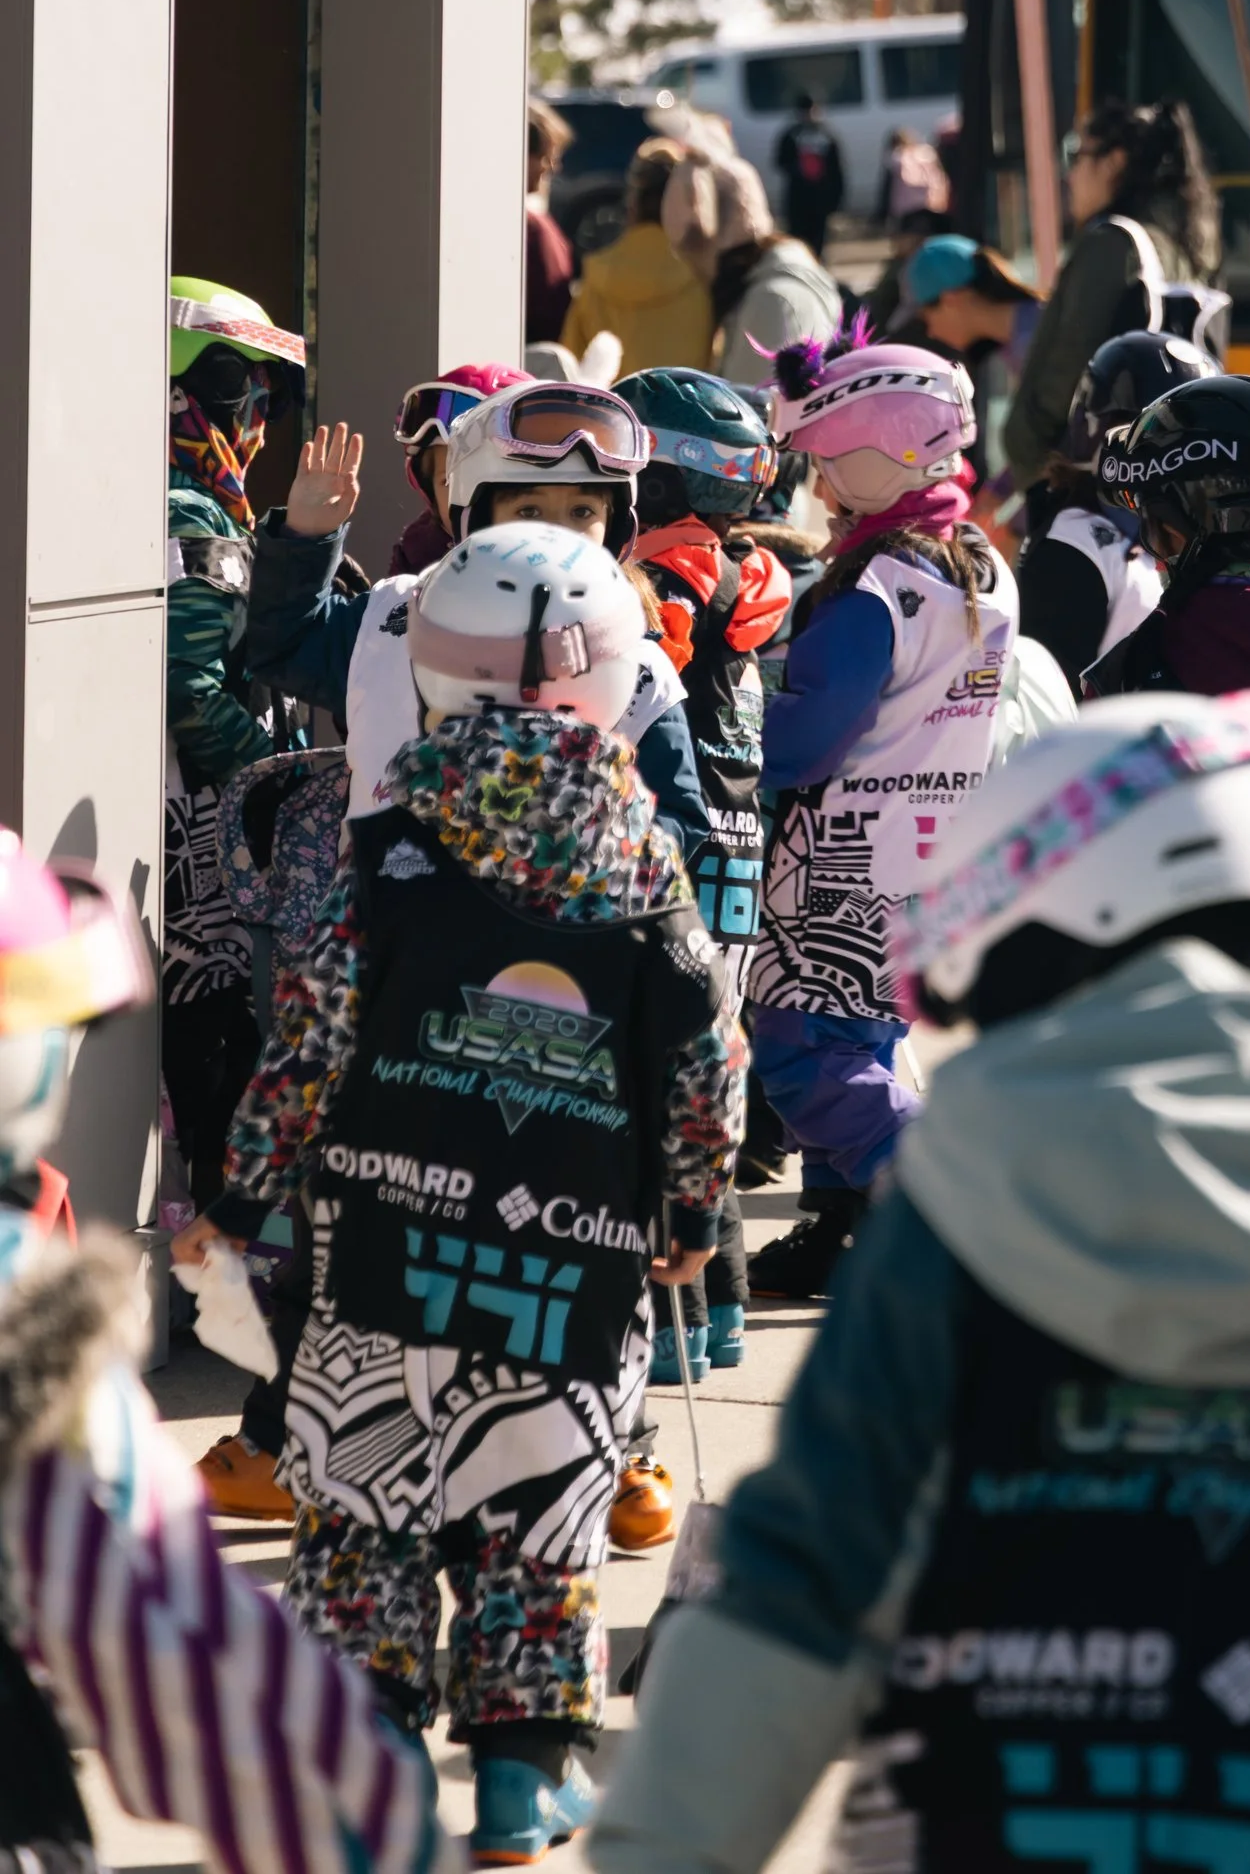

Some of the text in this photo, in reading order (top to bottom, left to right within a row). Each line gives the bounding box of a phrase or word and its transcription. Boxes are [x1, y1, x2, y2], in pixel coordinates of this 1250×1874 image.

[800, 373, 937, 419] SCOTT
[1117, 438, 1239, 483] DRAGON
[842, 772, 985, 794] WOODWARD
[908, 793, 955, 804] COPPER
[488, 997, 580, 1038] 2020
[420, 1011, 617, 1099] USASA
[371, 1054, 631, 1136] NATIONAL CHAMPIONSHIP
[442, 1205, 469, 1222] CO
